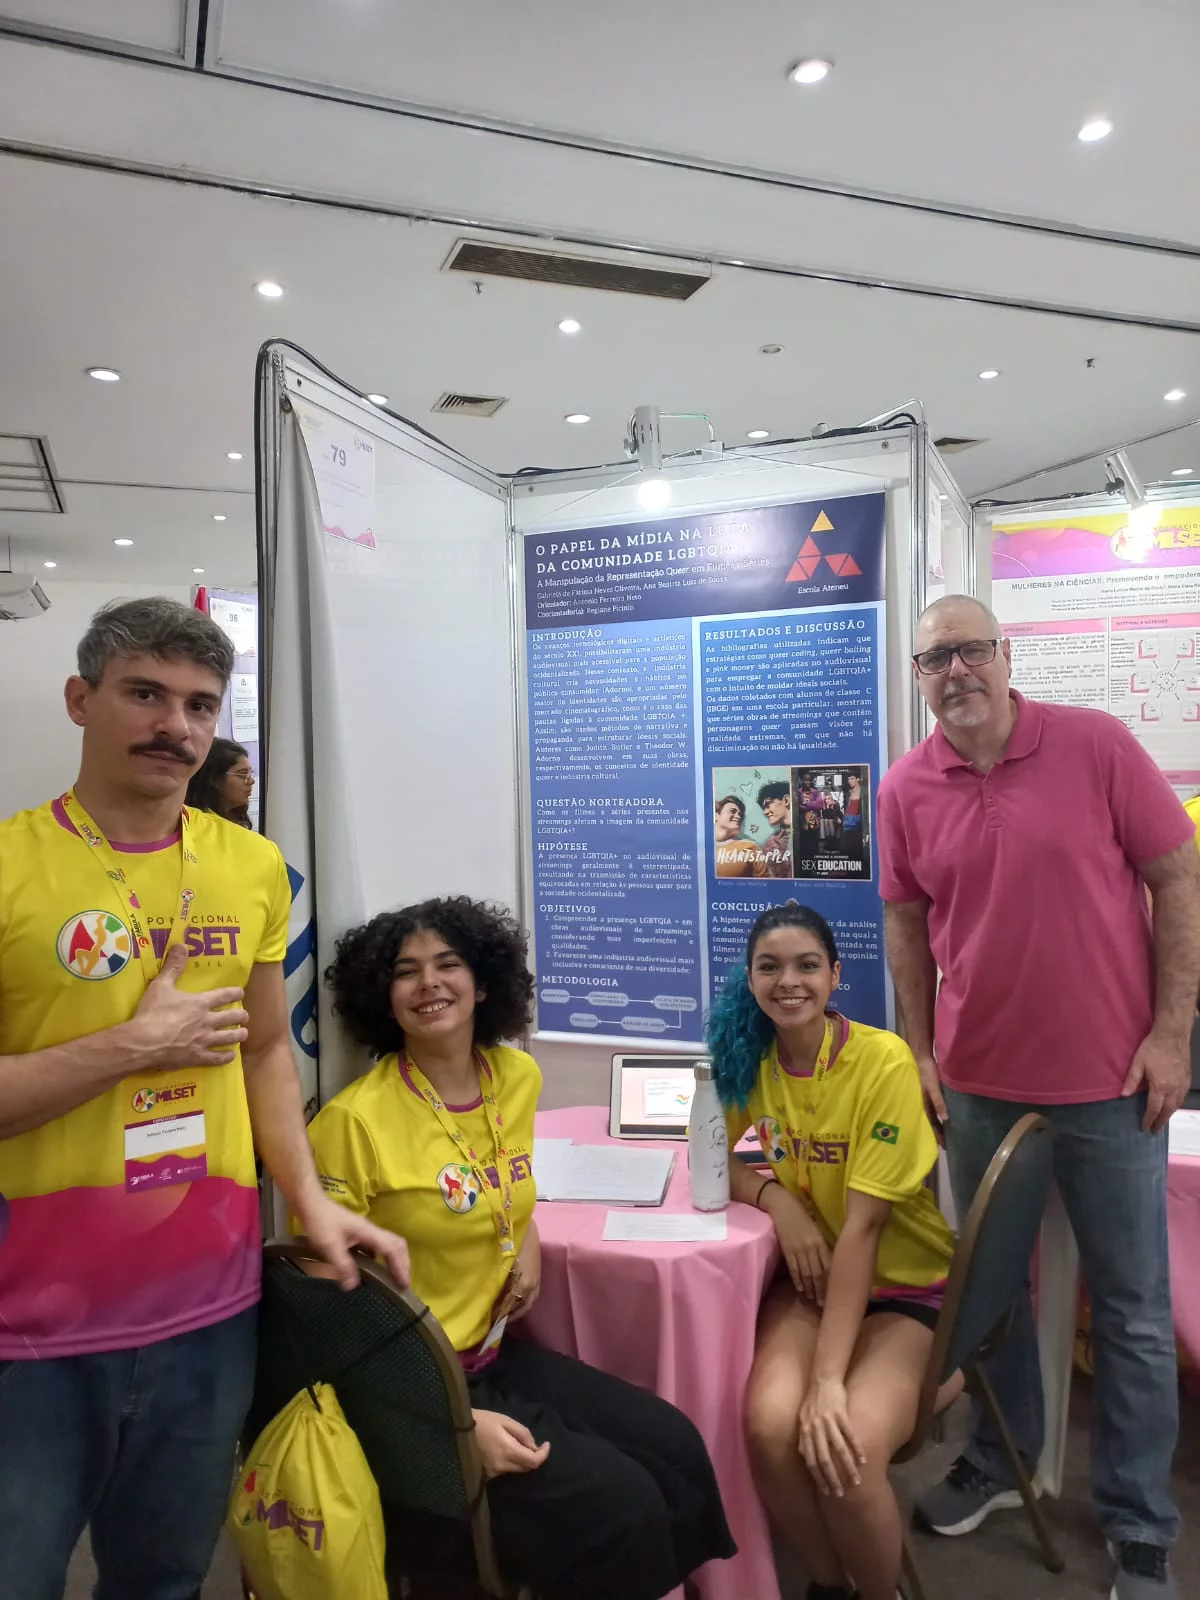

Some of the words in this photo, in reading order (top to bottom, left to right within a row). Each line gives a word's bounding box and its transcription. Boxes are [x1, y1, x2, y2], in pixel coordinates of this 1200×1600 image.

[330, 444, 346, 467] 79
[536, 546, 545, 556] O
[550, 542, 595, 555] PAPEL
[601, 538, 621, 549] DA
[627, 531, 673, 546] MÍDIA
[680, 528, 701, 540] NA
[537, 562, 556, 574] DA
[562, 551, 662, 571] COMUNIDADE
[537, 580, 543, 588] A
[545, 576, 594, 588] Manipulação
[595, 573, 604, 582] da
[607, 568, 664, 582] Representação
[666, 566, 688, 576] Queer
[1012, 582, 1052, 590] MULHERES
[229, 614, 238, 622] 96
[705, 628, 781, 640] RESULTADOS
[786, 626, 792, 634] E
[796, 620, 865, 634] DISCUSSÃO
[532, 629, 601, 642] INTRODUÇÃO
[768, 681, 793, 689] moldar
[796, 679, 818, 687] ideais
[742, 693, 776, 701] coletados
[708, 744, 758, 752] discriminação
[537, 798, 585, 808] QUESTÃO
[589, 798, 664, 806] NORTEADORA
[538, 841, 588, 851] HIPÓTESE
[717, 848, 790, 864] HEARTSTOPPER
[802, 860, 816, 870] SEX
[818, 860, 861, 871] EDUCATION
[540, 904, 596, 914] OBJETIVOS
[712, 902, 779, 911] CONCLUSÃ
[131, 926, 240, 959] MSET
[542, 976, 618, 986] METODOLOGIA
[155, 1085, 196, 1104] MILSET
